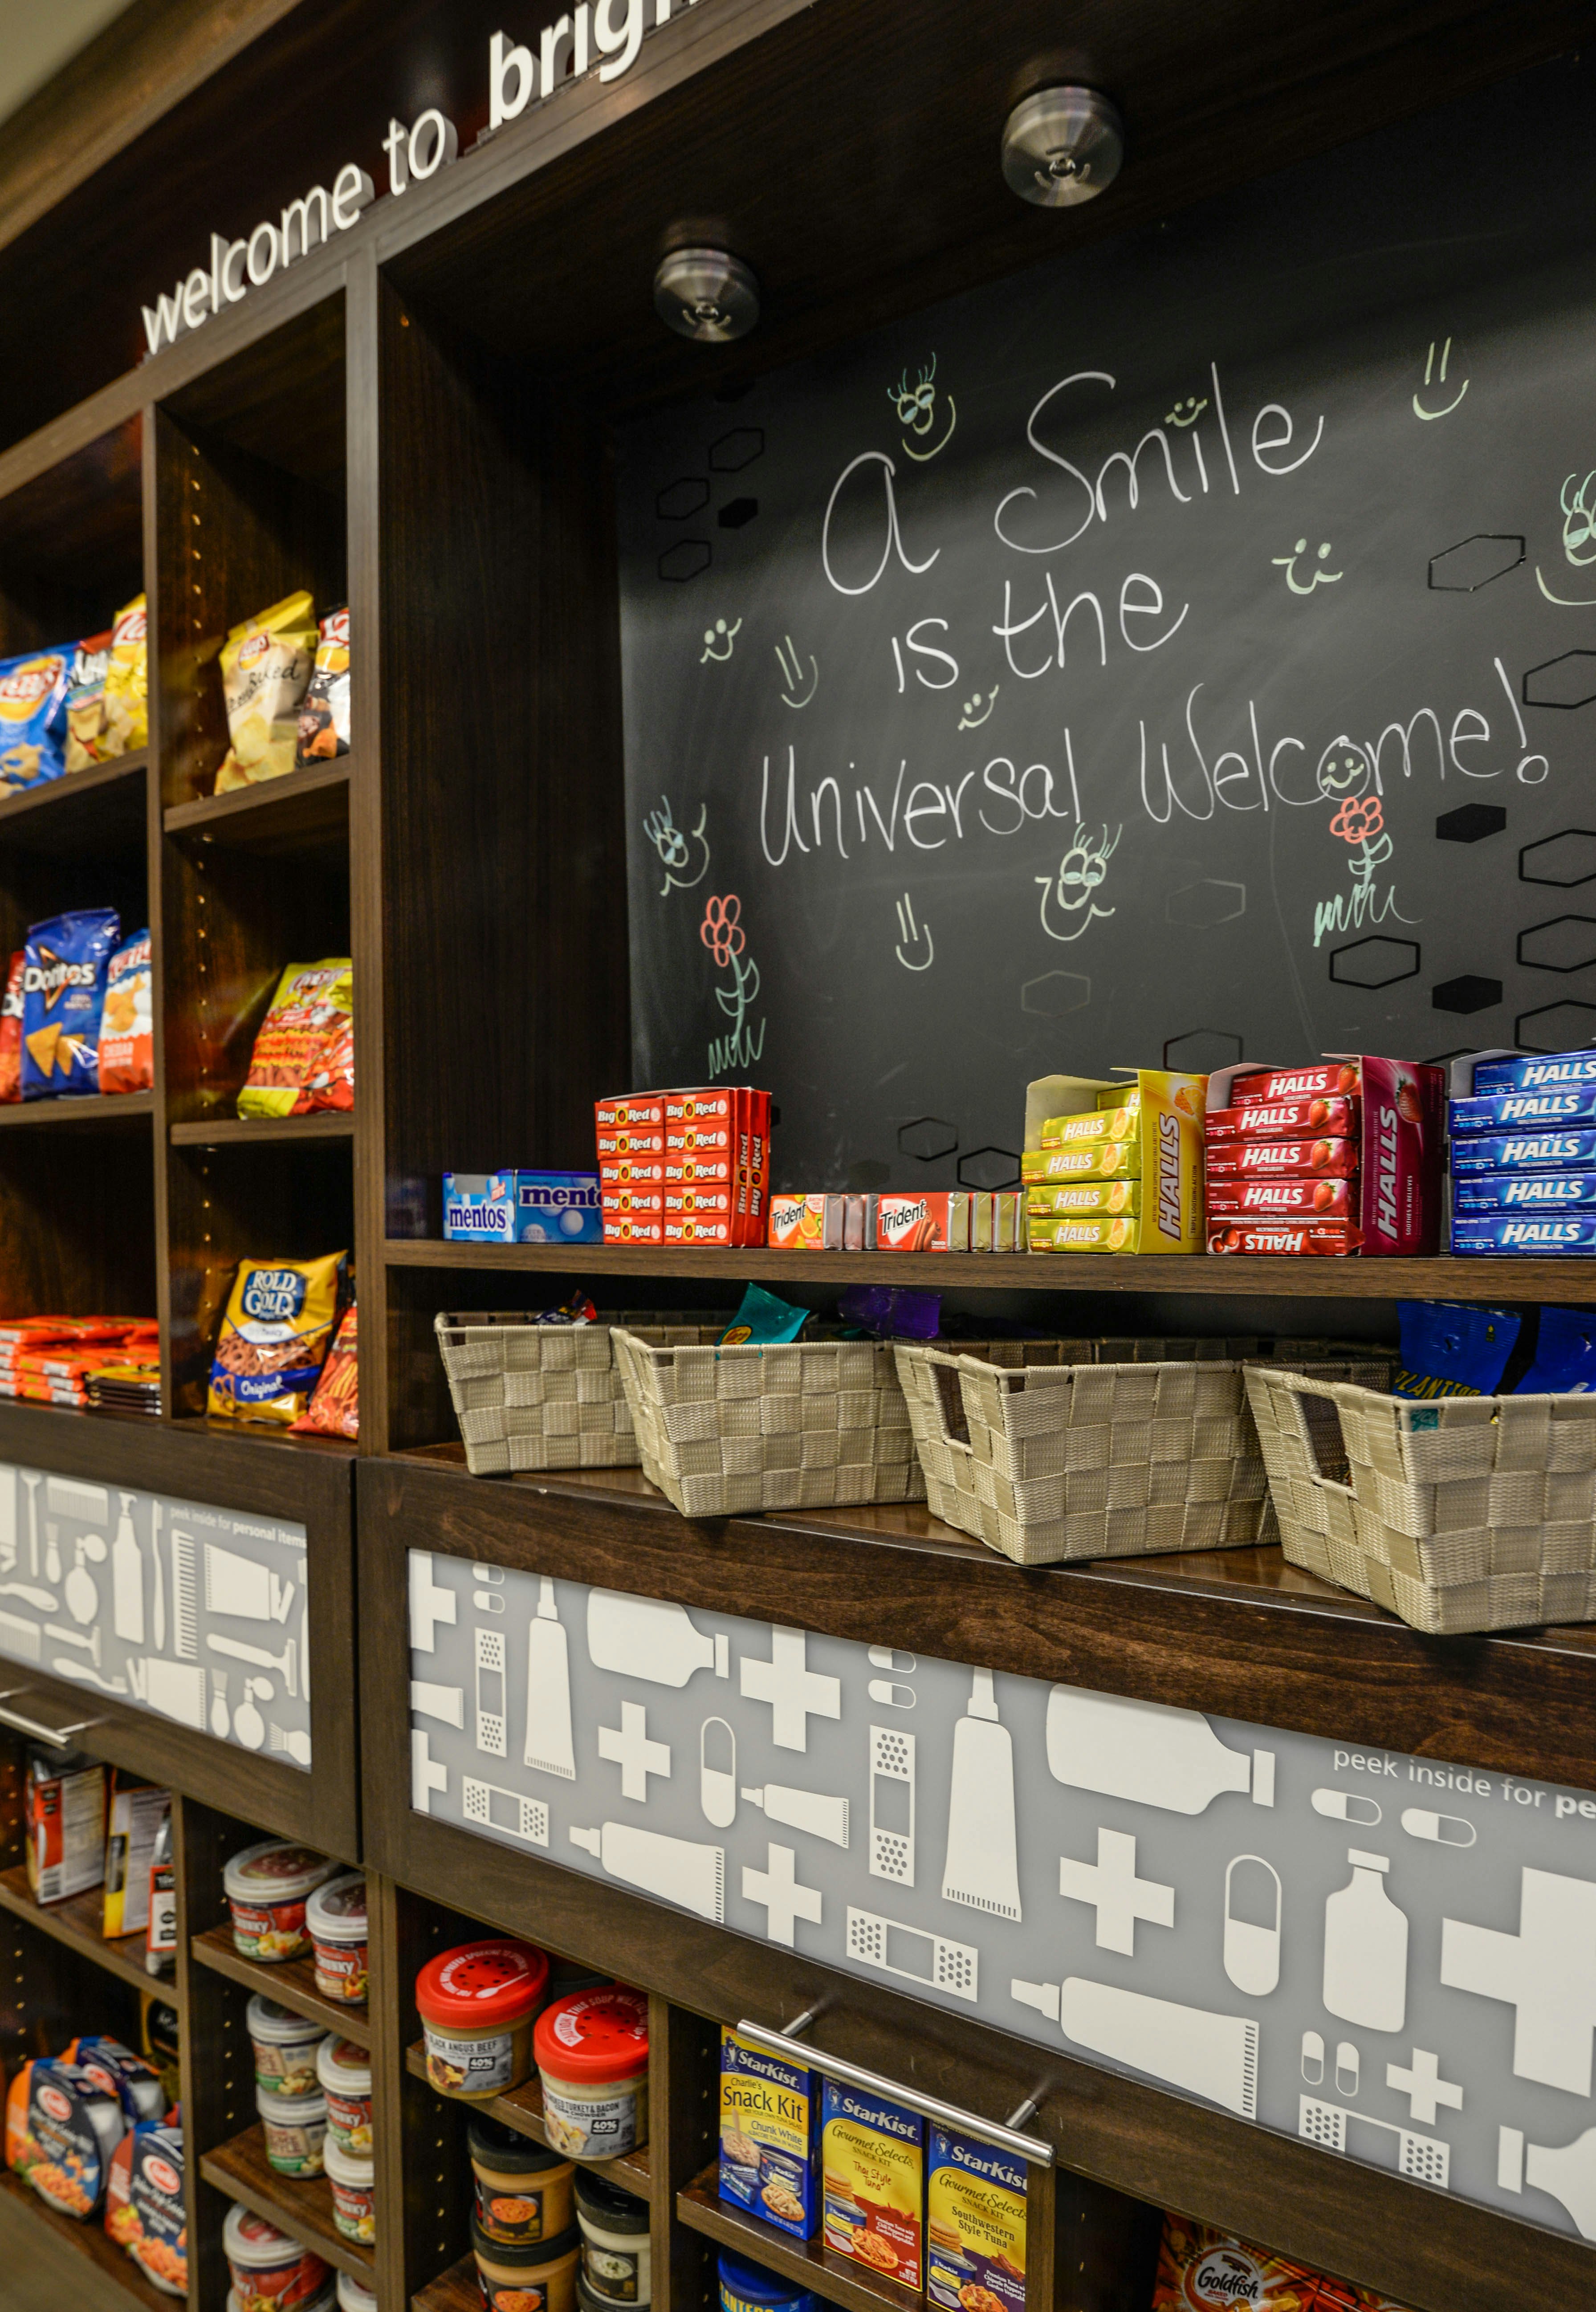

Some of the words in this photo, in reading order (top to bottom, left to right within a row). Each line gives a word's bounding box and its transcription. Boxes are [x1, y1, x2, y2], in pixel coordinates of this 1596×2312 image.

[142, 163, 363, 354] welcome
[383, 109, 446, 196] to
[994, 362, 1323, 553] Smile
[993, 573, 1188, 679] the
[760, 728, 1081, 866] Universal
[1140, 658, 1549, 823] Welcome!
[24, 962, 95, 993] Doritos
[1267, 1073, 1328, 1099] HALLS
[1521, 1060, 1596, 1088] HALLS
[598, 1110, 615, 1123] Big
[628, 1108, 650, 1122] Red
[667, 1104, 684, 1118] Big
[695, 1101, 717, 1116] Red
[1240, 1107, 1300, 1131] HALLS
[1499, 1095, 1580, 1122] HALLS
[668, 1135, 685, 1149] Big
[696, 1132, 717, 1147] Red
[1063, 1119, 1105, 1141] HALLS
[598, 1138, 616, 1152] Big
[629, 1137, 651, 1151] Red
[752, 1135, 762, 1169] Red
[1500, 1138, 1581, 1164] HALLS
[1048, 1153, 1094, 1176] HALLS
[1242, 1146, 1302, 1168] HALLS
[602, 1166, 619, 1180] Big
[631, 1165, 651, 1179] Red
[665, 1166, 683, 1180] Big
[695, 1164, 717, 1178] Red
[1158, 1112, 1181, 1242] HALLS
[1378, 1105, 1397, 1239] HALLS
[603, 1196, 619, 1209] Big
[631, 1196, 651, 1209] Red
[665, 1196, 683, 1210] Big
[695, 1195, 717, 1209] Red
[750, 1187, 762, 1216] Big
[1054, 1190, 1101, 1210] HALLS
[1243, 1187, 1304, 1207] HALLS
[1504, 1180, 1584, 1204] HALLS
[449, 1203, 506, 1229] mentos
[771, 1200, 807, 1233] Trident
[879, 1198, 927, 1236] Trident
[605, 1224, 620, 1238] Big
[631, 1225, 651, 1238] Red
[665, 1225, 683, 1239] Big
[695, 1225, 717, 1238] Red
[1054, 1225, 1101, 1245] HALLS
[1244, 1232, 1304, 1252] HALLS
[1500, 1223, 1581, 1245] HALLS
[252, 1270, 297, 1291] ROLD
[244, 1290, 296, 1316] GOLD
[240, 1375, 284, 1399] Original
[1334, 1749, 1398, 1778] peek
[1409, 1759, 1491, 1797] inside
[1501, 1778, 1546, 1807] for
[448, 2040, 475, 2052] ANGUS
[477, 2039, 498, 2052] BEEF
[470, 2058, 494, 2067] 40%
[738, 2051, 800, 2088] StarKist
[731, 2077, 762, 2090] Charlie's
[596, 2102, 620, 2113] BACON
[723, 2086, 774, 2113] Snack
[778, 2094, 803, 2123] Kit
[593, 2121, 618, 2129] 40%
[842, 2097, 916, 2139] StarKist
[751, 2120, 777, 2134] Chunk
[778, 2127, 803, 2146] White
[832, 2125, 875, 2151] Gourmet
[875, 2142, 913, 2167] Selects
[852, 2146, 878, 2162] SNACK
[879, 2158, 892, 2167] KIT
[853, 2161, 869, 2176] Thai
[871, 2169, 892, 2186] Style
[863, 2176, 881, 2192] Tuna
[940, 2174, 987, 2202] Gourmet
[962, 2197, 989, 2214] SNACK
[990, 2209, 1006, 2220] KIT
[952, 2206, 1015, 2242] Southwestern
[958, 2219, 981, 2237] Style
[983, 2231, 1008, 2249] Tuna
[1197, 2266, 1258, 2299] Goldfish
